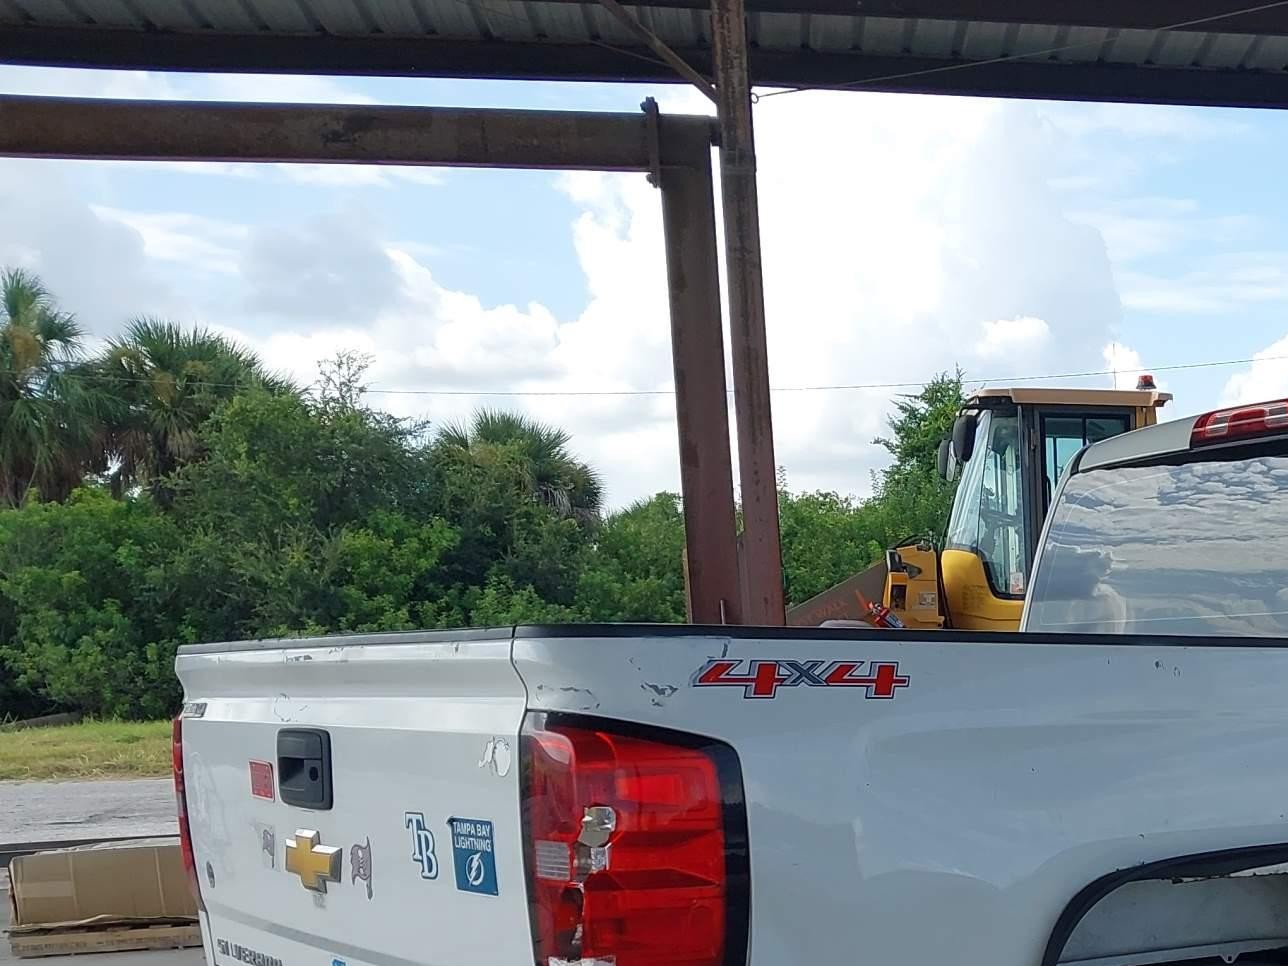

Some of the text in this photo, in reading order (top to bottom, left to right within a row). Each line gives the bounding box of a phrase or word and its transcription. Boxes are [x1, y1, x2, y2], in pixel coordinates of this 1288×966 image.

[453, 821, 490, 837] TAMPA BAY
[455, 836, 492, 852] LIGHTNING
